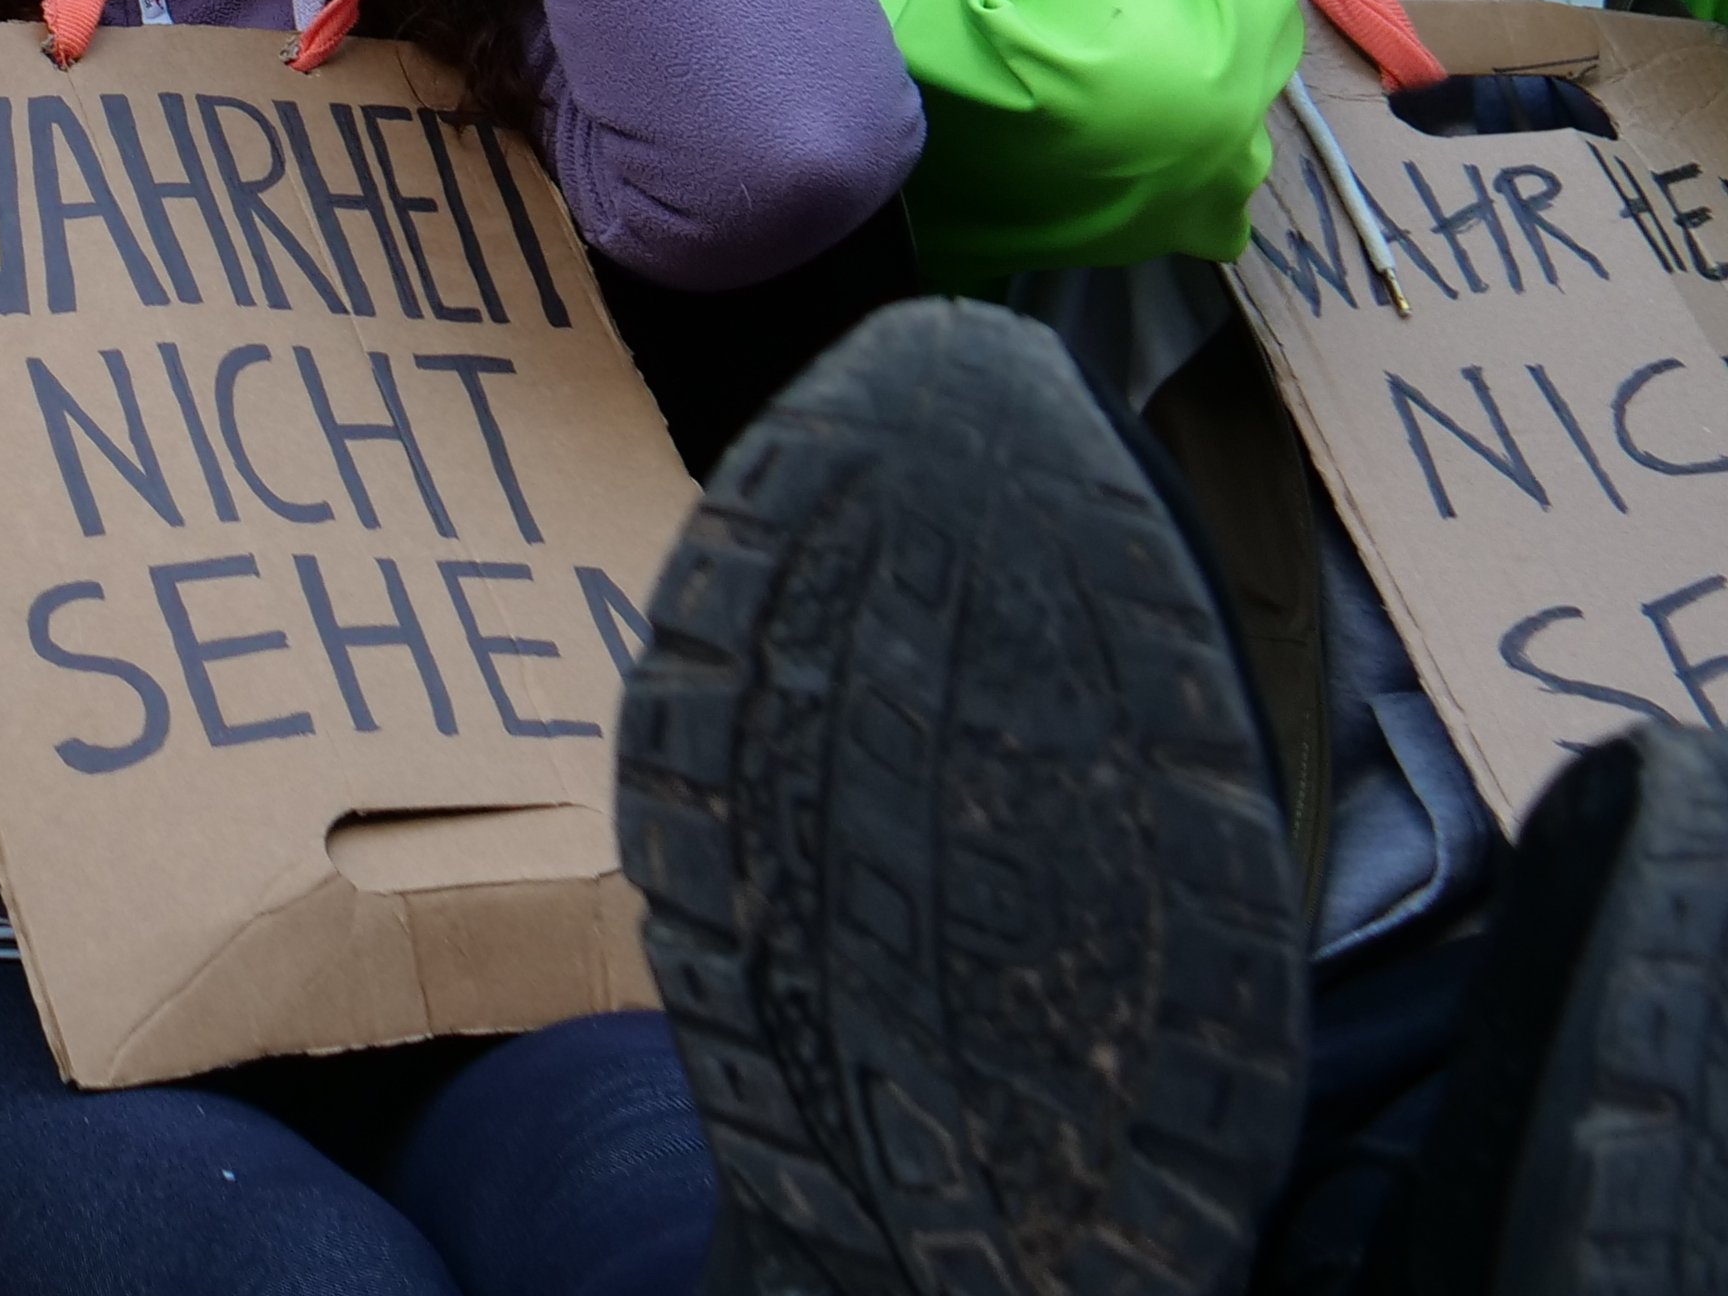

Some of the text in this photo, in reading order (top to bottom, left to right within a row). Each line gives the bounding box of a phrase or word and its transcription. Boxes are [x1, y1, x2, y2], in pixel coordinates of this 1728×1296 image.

[1249, 141, 1728, 317] WAHRHE
[26, 340, 544, 544] NICHT
[1384, 356, 1728, 519] NIC
